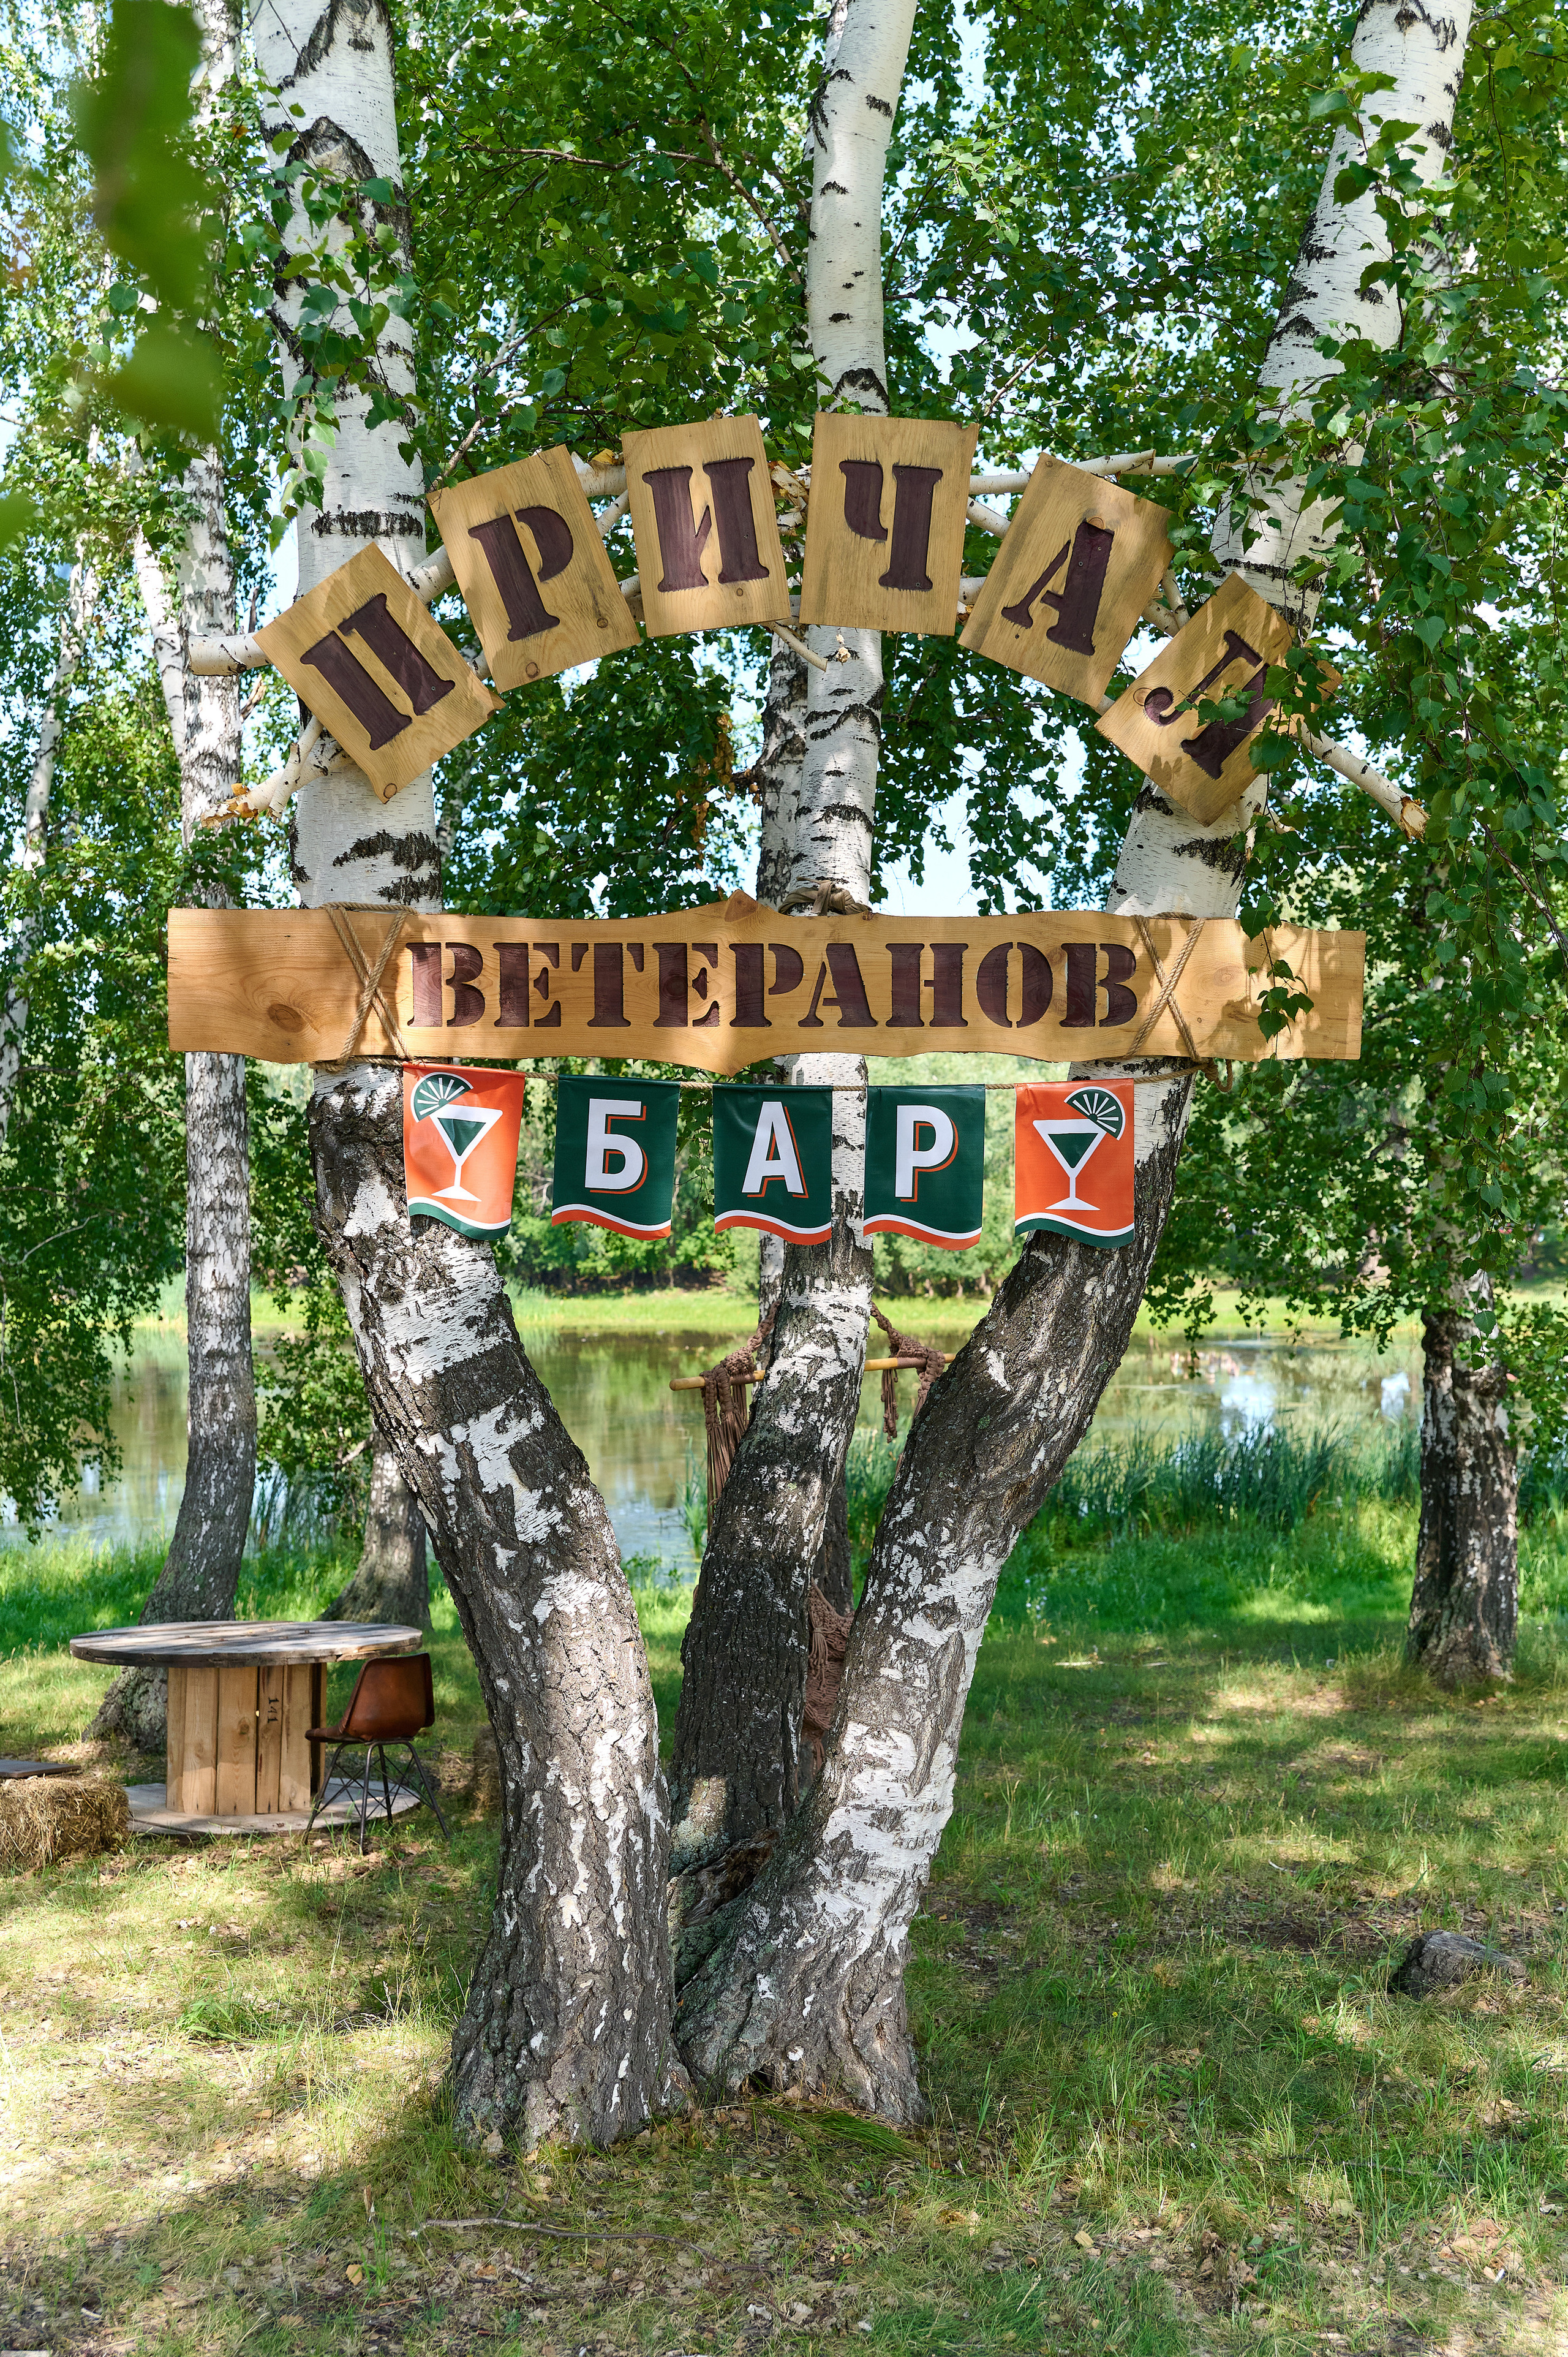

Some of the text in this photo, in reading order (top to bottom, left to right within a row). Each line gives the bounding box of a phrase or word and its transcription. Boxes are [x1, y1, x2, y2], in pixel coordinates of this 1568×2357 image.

[300, 456, 1281, 780] ПРИЧАЛ
[405, 942, 1138, 1028] ВЕТЕРАНОВ
[584, 1098, 959, 1202] БАР
[267, 1697, 279, 1723] 141
